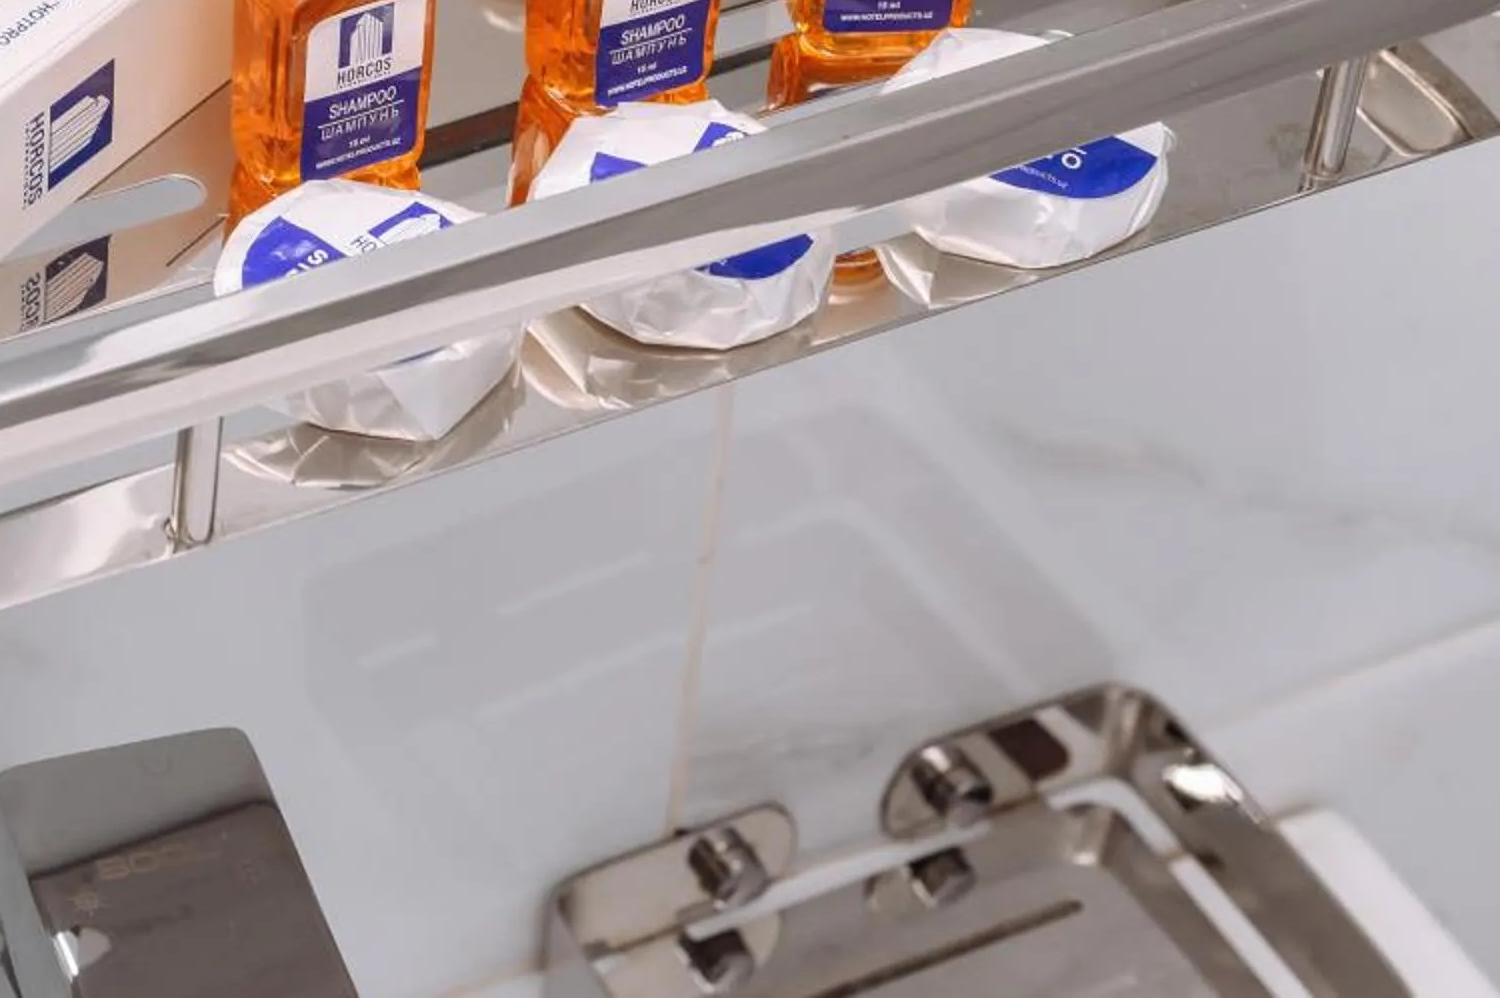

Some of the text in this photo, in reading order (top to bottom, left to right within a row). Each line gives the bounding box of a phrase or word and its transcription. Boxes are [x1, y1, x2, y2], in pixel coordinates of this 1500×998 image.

[619, 13, 685, 45] SHAMPOO
[611, 33, 688, 64] ШАМПУНЬ
[336, 56, 392, 86] HORCOS
[328, 85, 397, 120] SHAMPOO
[320, 105, 399, 141] ШАМПУНЬ
[29, 111, 45, 206] HORCOS
